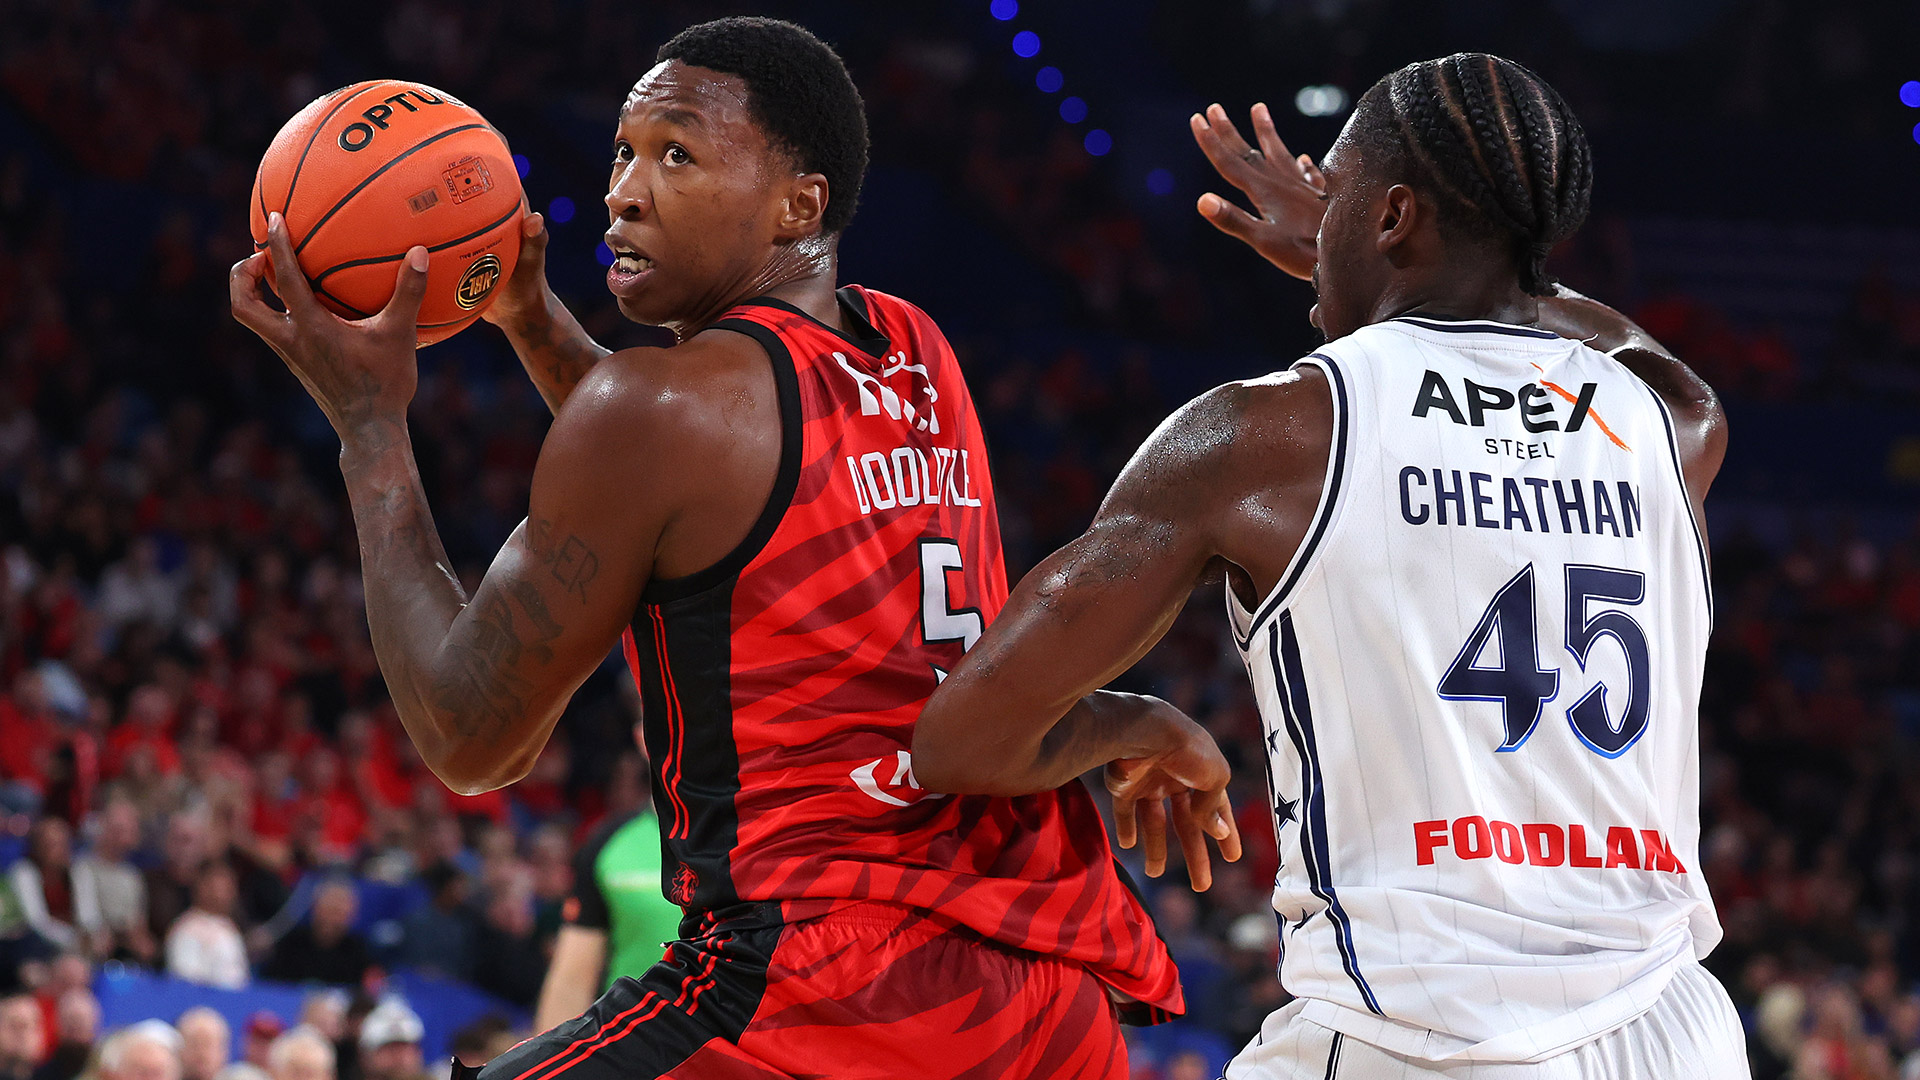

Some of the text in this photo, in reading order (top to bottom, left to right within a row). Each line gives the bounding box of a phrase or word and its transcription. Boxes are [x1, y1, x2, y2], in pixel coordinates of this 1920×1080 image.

[469, 269, 494, 297] NBL
[1411, 362, 1633, 454] APEX
[1485, 438, 1556, 459] STEEL
[918, 536, 987, 687] 5
[1437, 560, 1651, 760] 45
